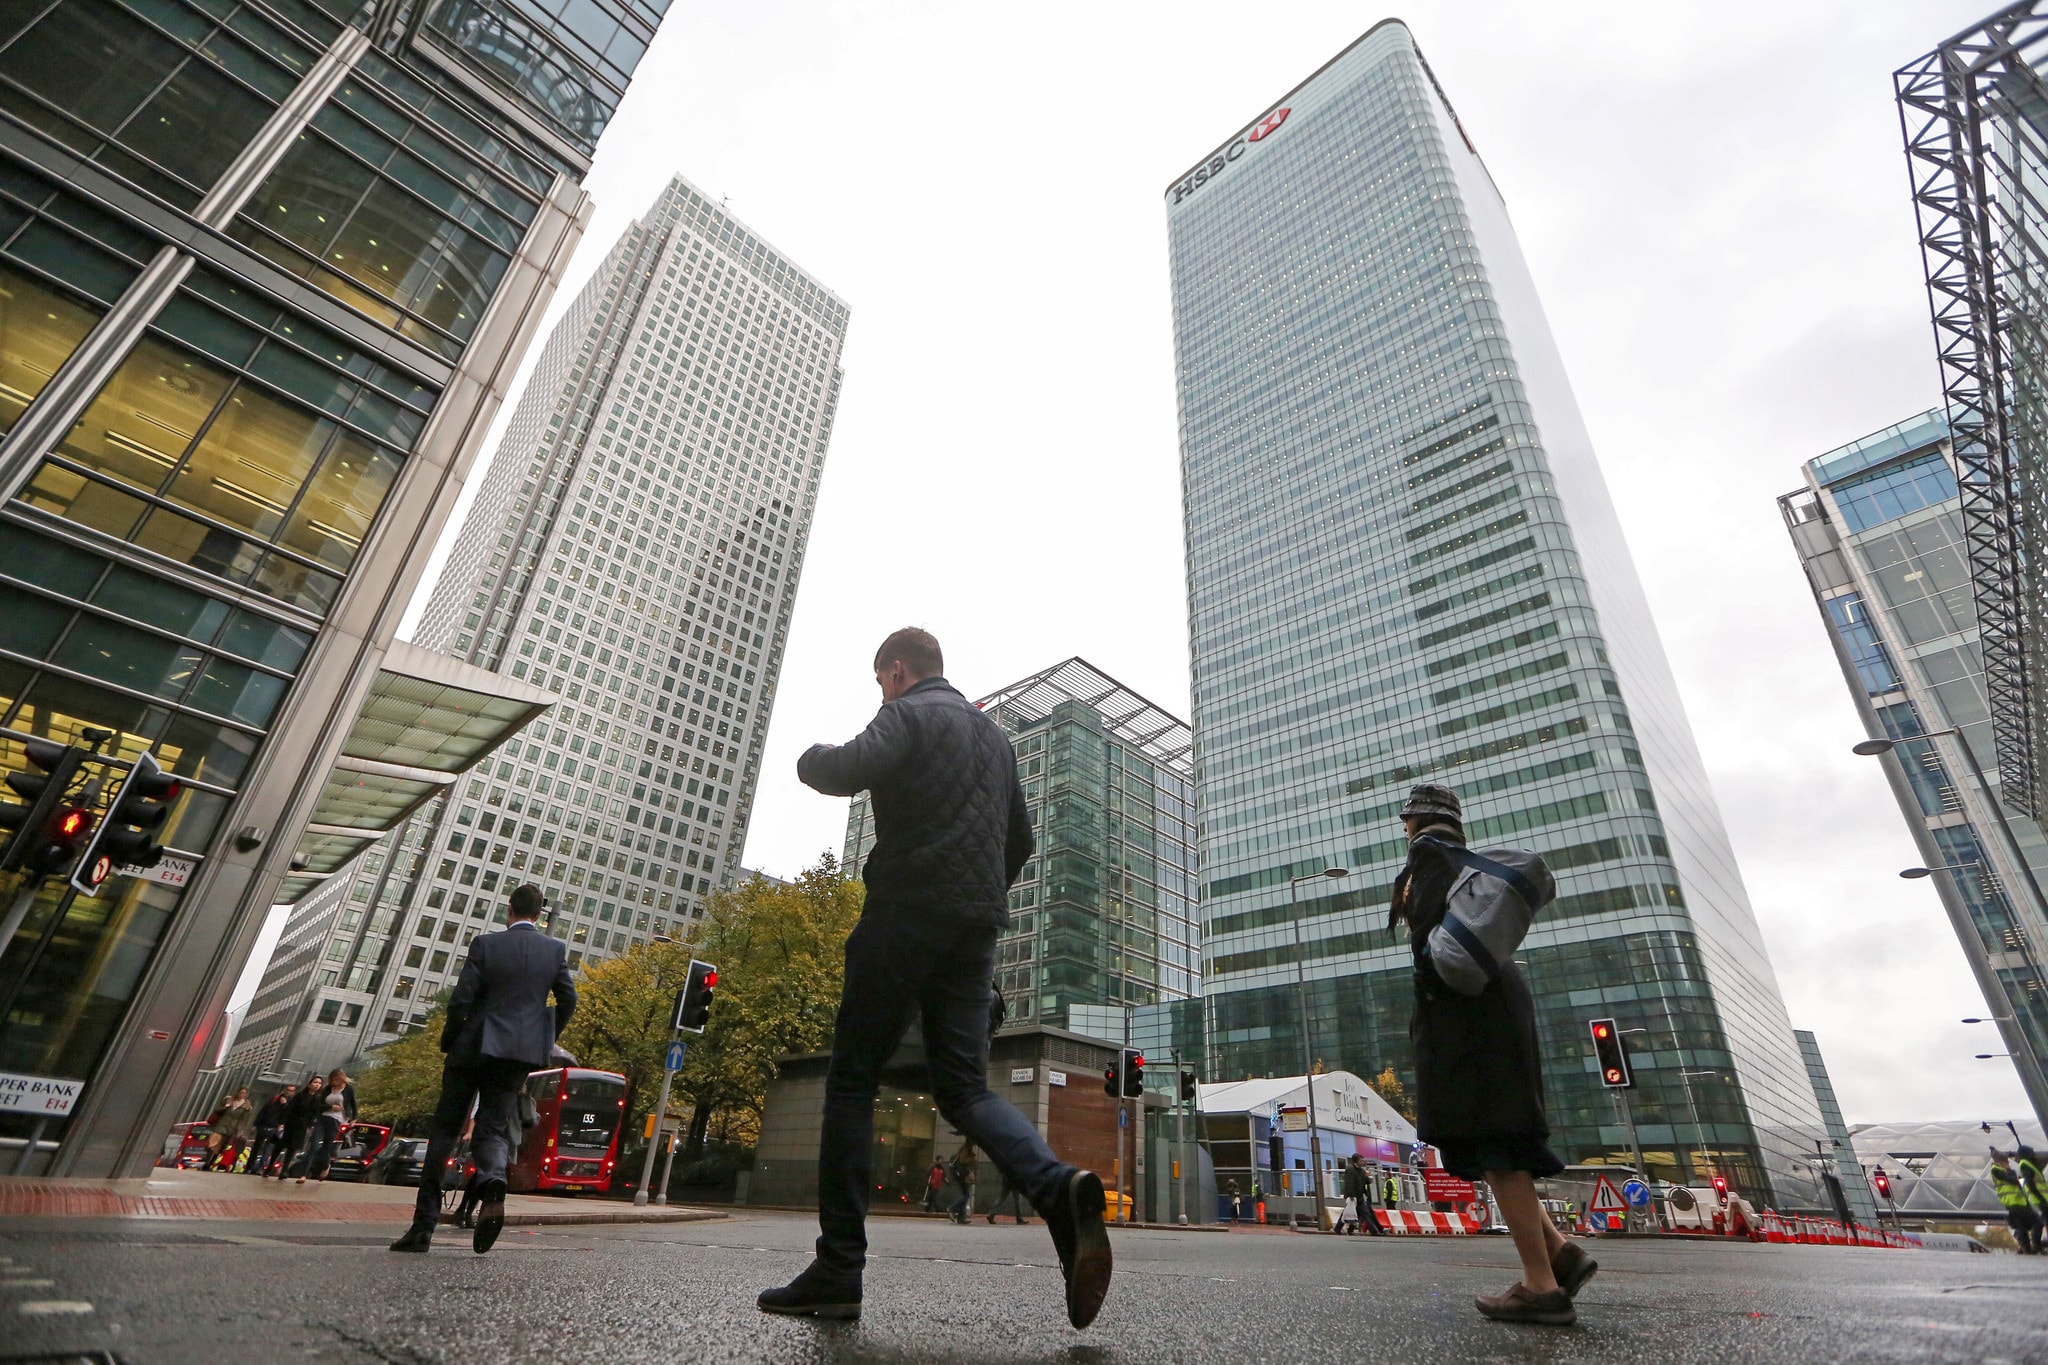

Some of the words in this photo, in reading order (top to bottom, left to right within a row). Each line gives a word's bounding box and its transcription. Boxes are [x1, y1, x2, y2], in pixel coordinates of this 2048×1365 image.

[1173, 138, 1245, 205] HSBC
[161, 871, 184, 883] E14
[31, 1082, 76, 1096] BANK
[45, 1098, 68, 1110] E14
[582, 1113, 595, 1123] 135
[1335, 1107, 1355, 1130] Canary
[1354, 1111, 1371, 1135] Wharf
